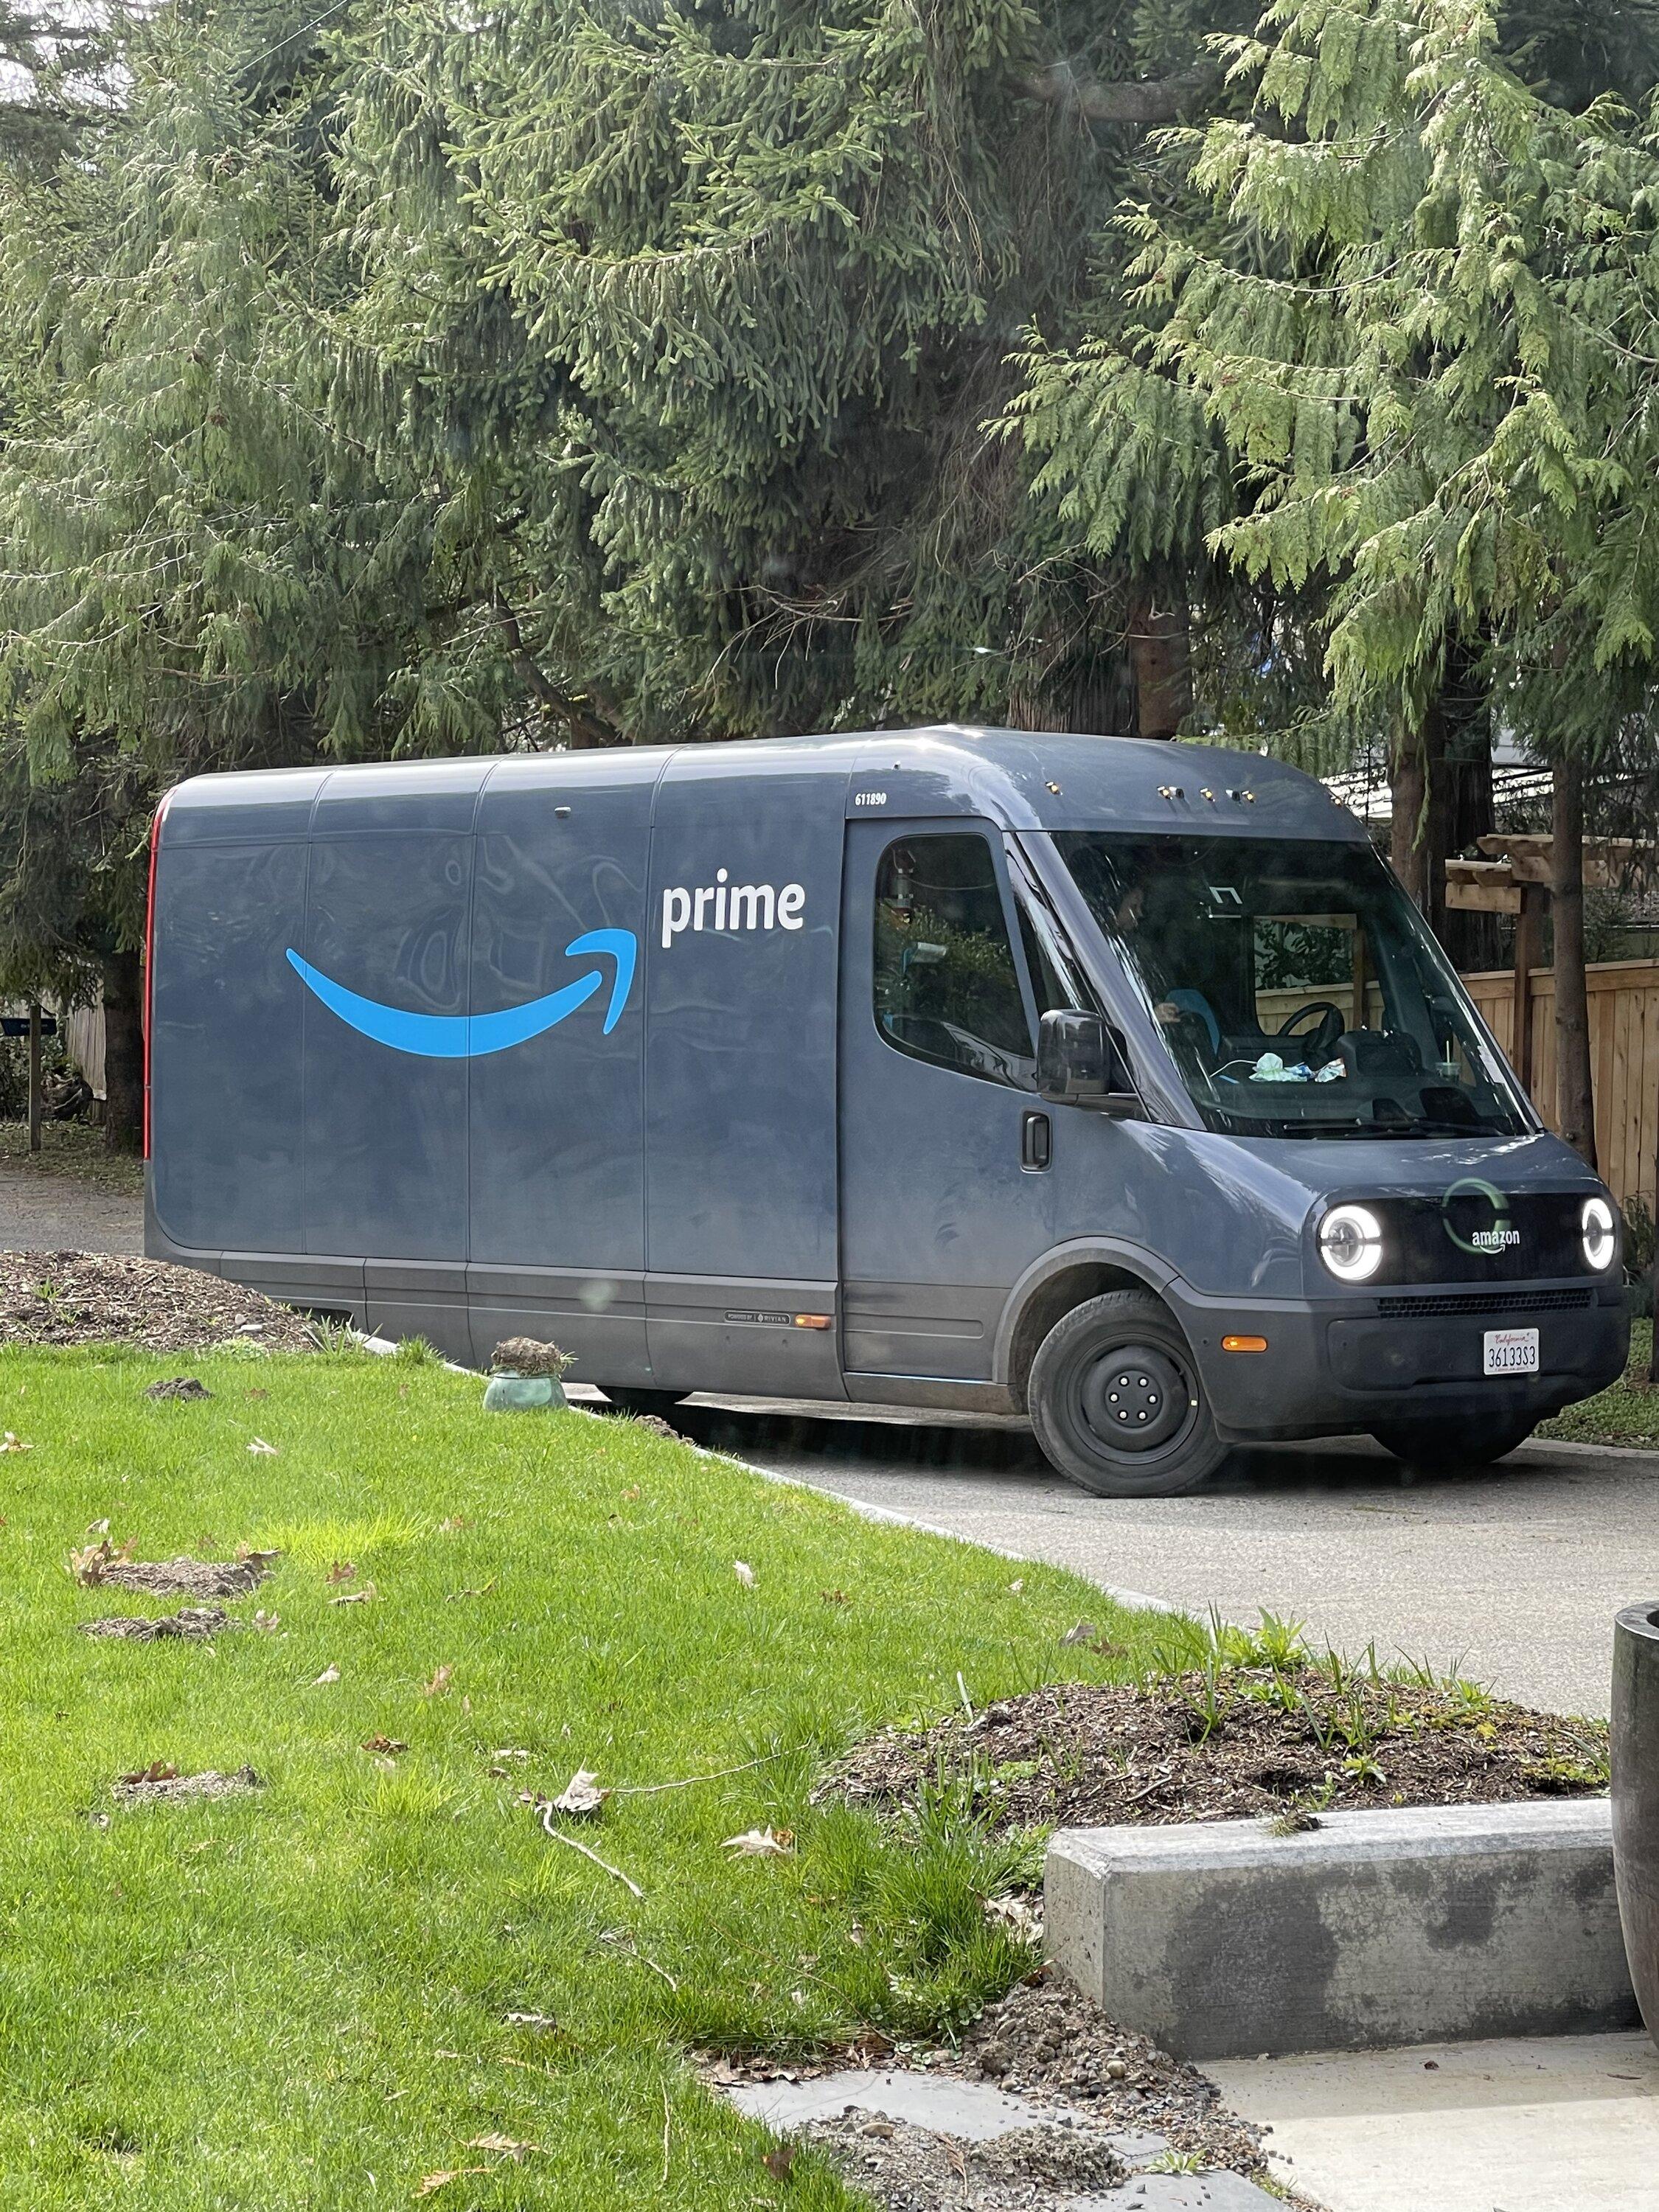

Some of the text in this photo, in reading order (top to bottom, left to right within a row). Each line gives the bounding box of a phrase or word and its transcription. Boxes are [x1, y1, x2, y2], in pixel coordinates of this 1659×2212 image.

[855, 793, 887, 805] 611890
[661, 868, 805, 948] prime
[1472, 1231, 1520, 1246] amazon
[1495, 1333, 1529, 1346] California
[1489, 1346, 1535, 1367] 36133S3
